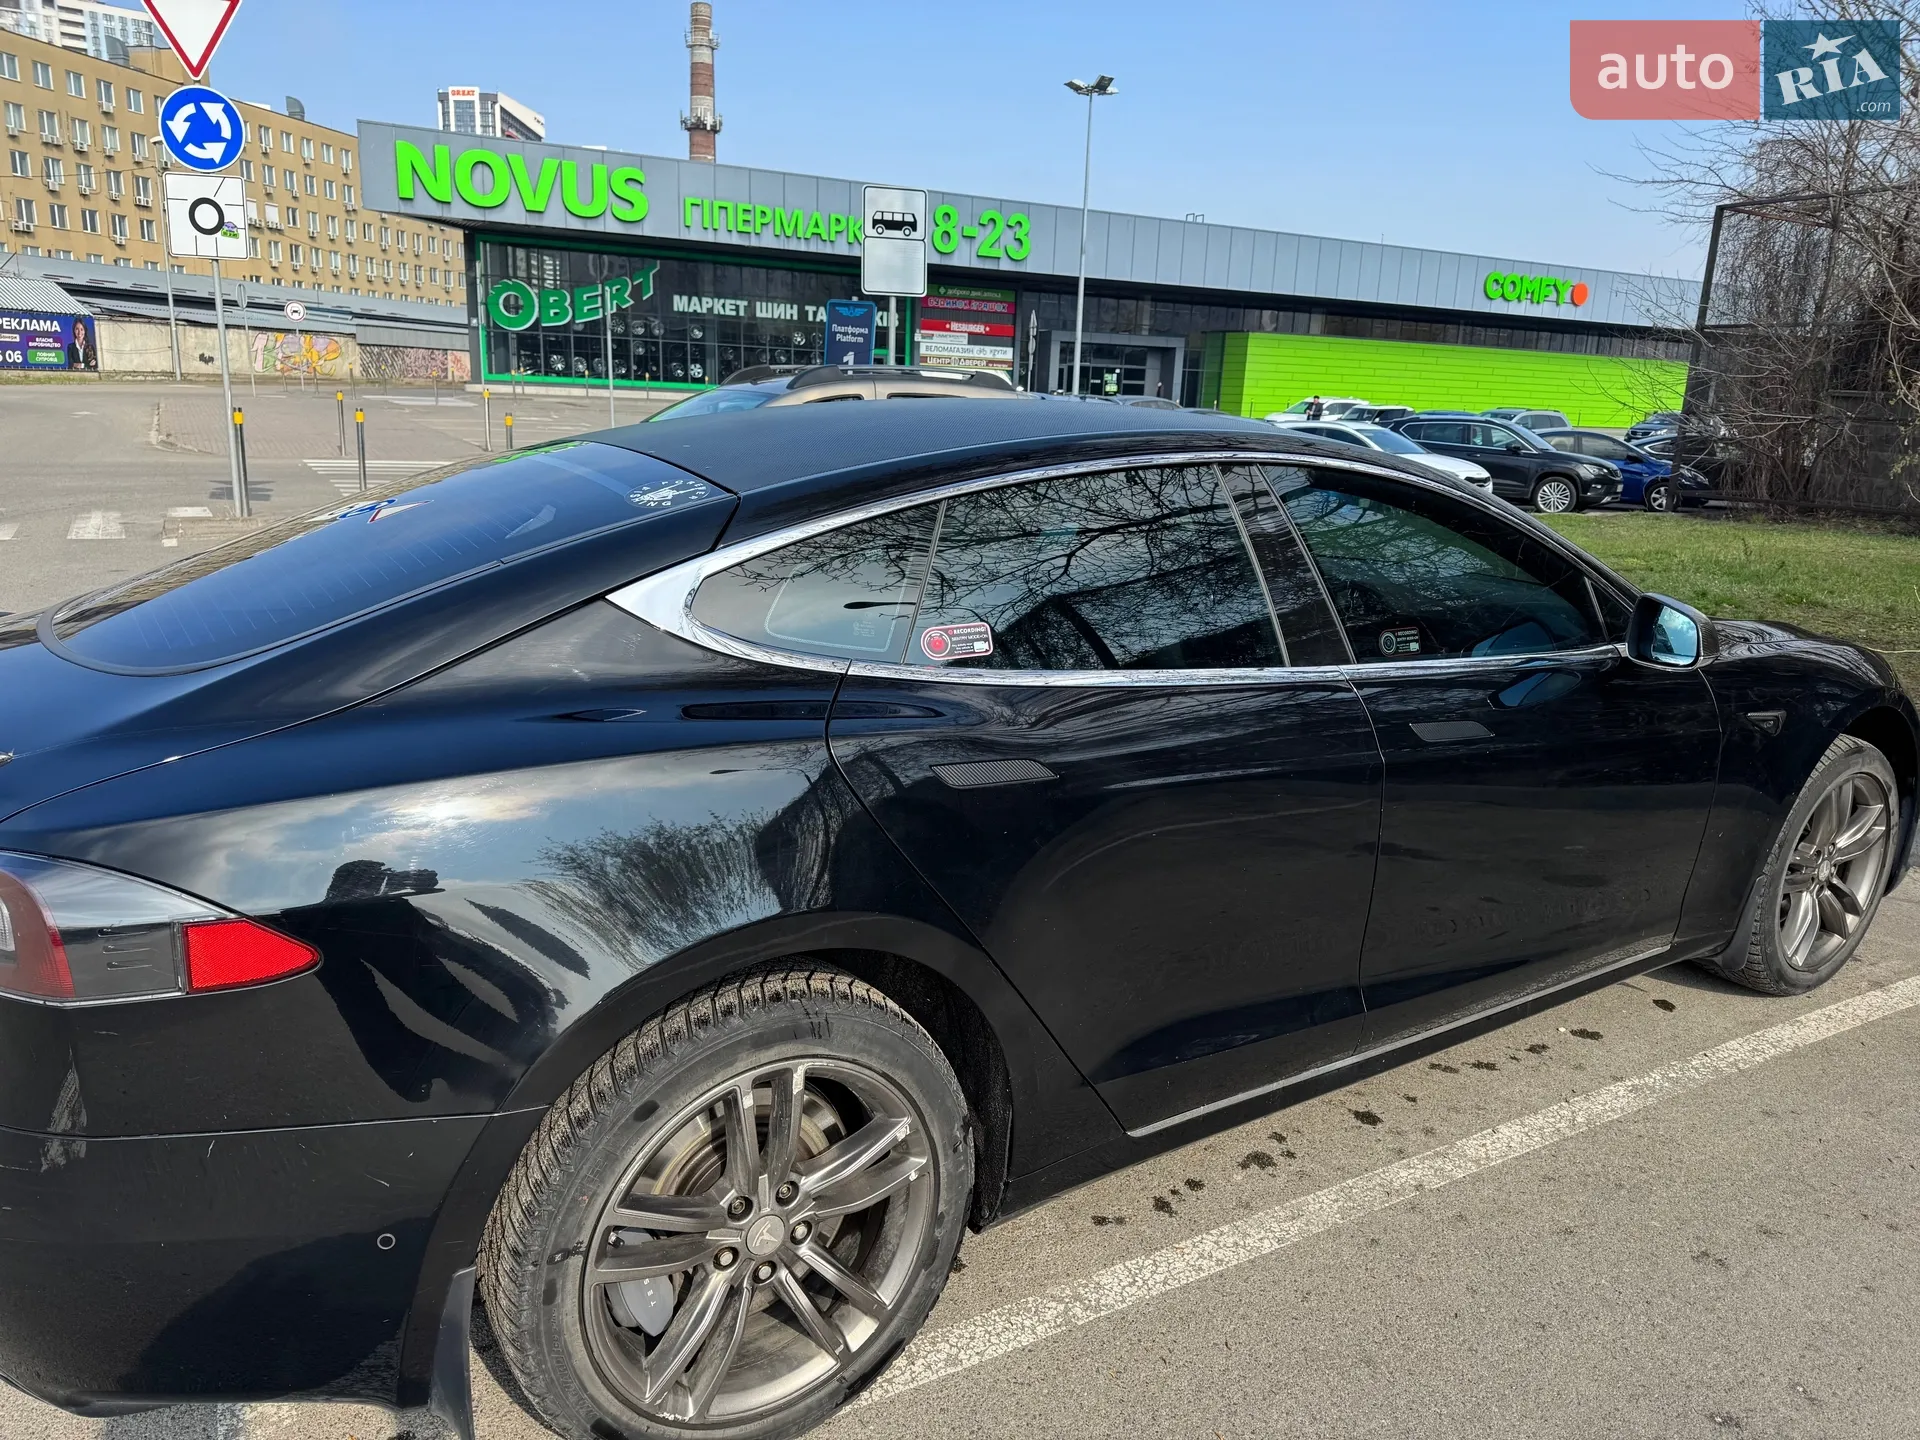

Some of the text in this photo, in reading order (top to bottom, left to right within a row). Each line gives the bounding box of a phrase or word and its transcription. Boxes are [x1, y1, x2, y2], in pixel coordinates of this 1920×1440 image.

[395, 140, 649, 222] NOVUS
[684, 197, 1031, 261] ГІПЕРМАРК 8-23
[486, 259, 661, 331] OBERT
[1484, 271, 1573, 305] COMFY
[673, 295, 826, 322] МАРКЕТ ШИН ТА
[928, 297, 969, 309] БУДИНОК
[0, 318, 61, 332] ЕКЛАМА
[832, 324, 868, 335] Платформа
[836, 333, 863, 343] Platform
[5, 350, 23, 363] 06
[925, 345, 975, 355] ВЕЛОМАГАЗИН
